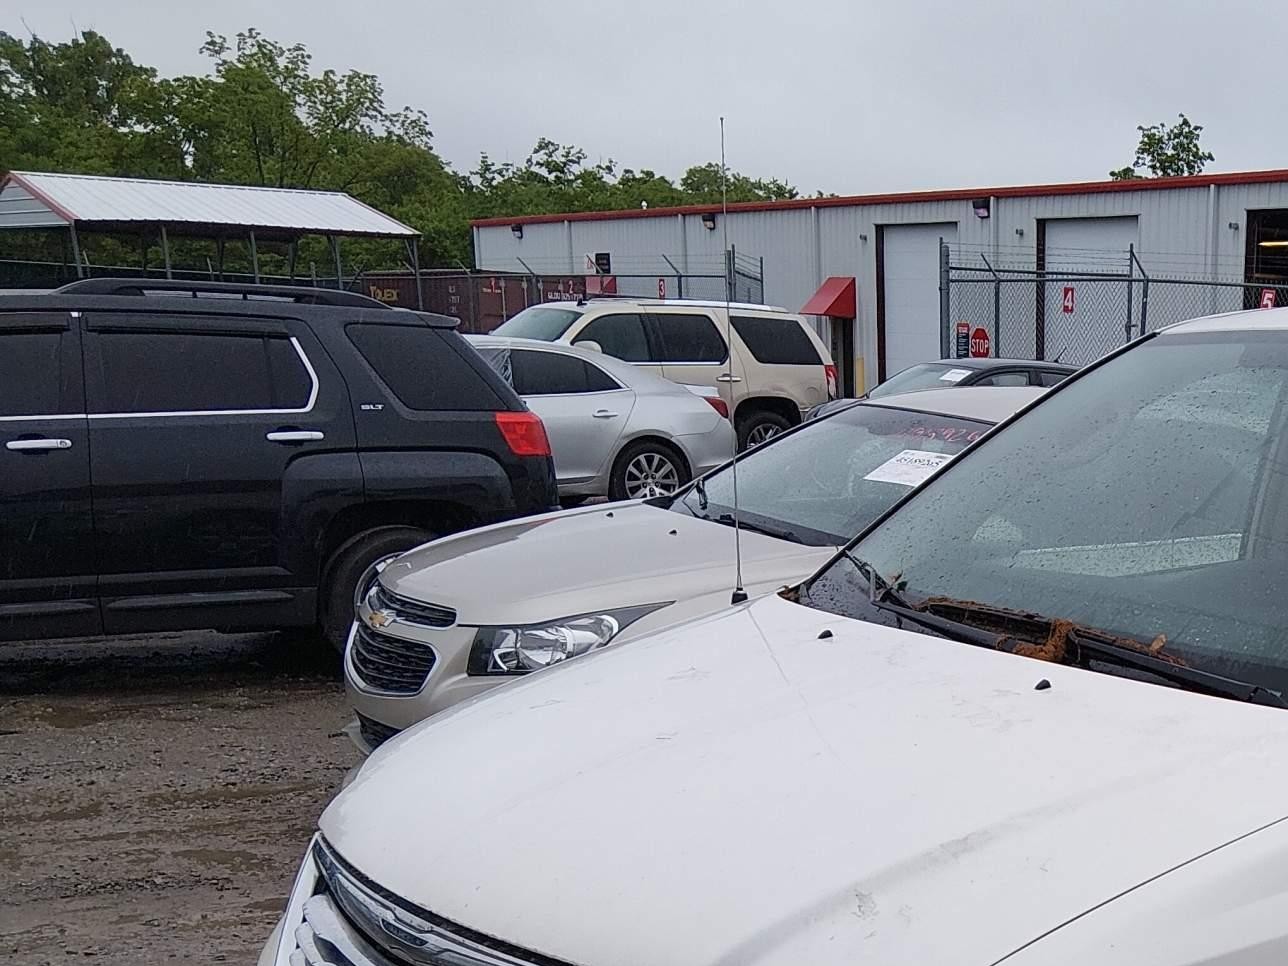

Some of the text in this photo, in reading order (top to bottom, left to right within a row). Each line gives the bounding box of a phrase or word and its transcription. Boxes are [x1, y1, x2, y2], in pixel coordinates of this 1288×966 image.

[658, 283, 665, 296] 3
[1063, 290, 1073, 311] 4
[1262, 293, 1273, 309] 5
[971, 339, 989, 353] STOP
